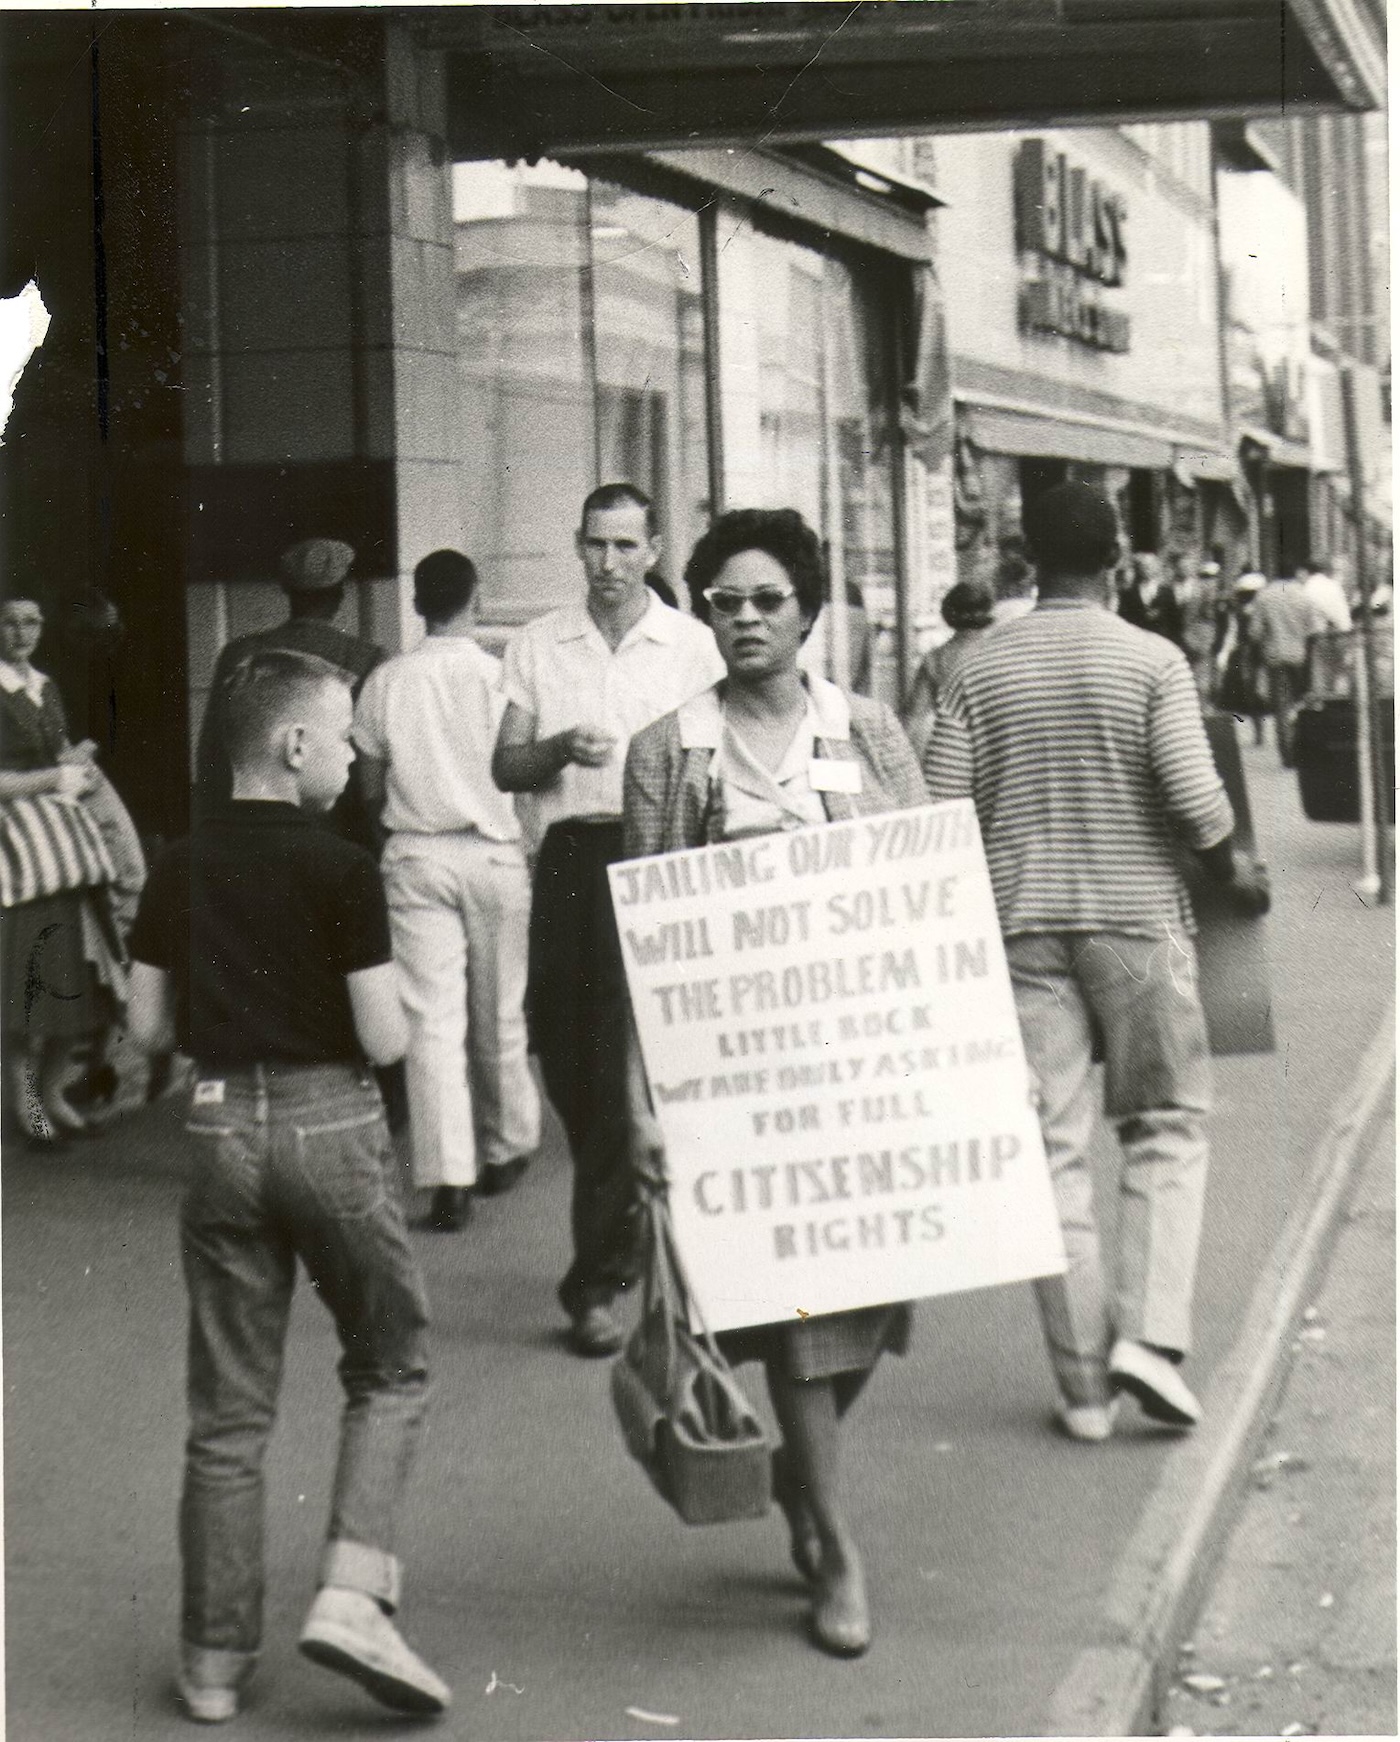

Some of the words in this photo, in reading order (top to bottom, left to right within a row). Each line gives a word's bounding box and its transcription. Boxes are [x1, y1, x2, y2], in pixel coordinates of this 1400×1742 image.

[616, 842, 775, 906] JAILING
[866, 809, 974, 866] YOUTH
[625, 917, 713, 966] WILL
[732, 900, 812, 951] NOT
[826, 876, 960, 935] SOLVE
[652, 978, 723, 1026] THE
[729, 948, 922, 1016] PROBLEM
[935, 938, 989, 984] IN
[718, 1020, 826, 1058] LITTLE
[838, 1003, 933, 1042] ROCK
[873, 1035, 1016, 1077] ASKING
[752, 1104, 820, 1136] FOR
[838, 1089, 933, 1128] FULL
[772, 1204, 946, 1259] RIGHTS
